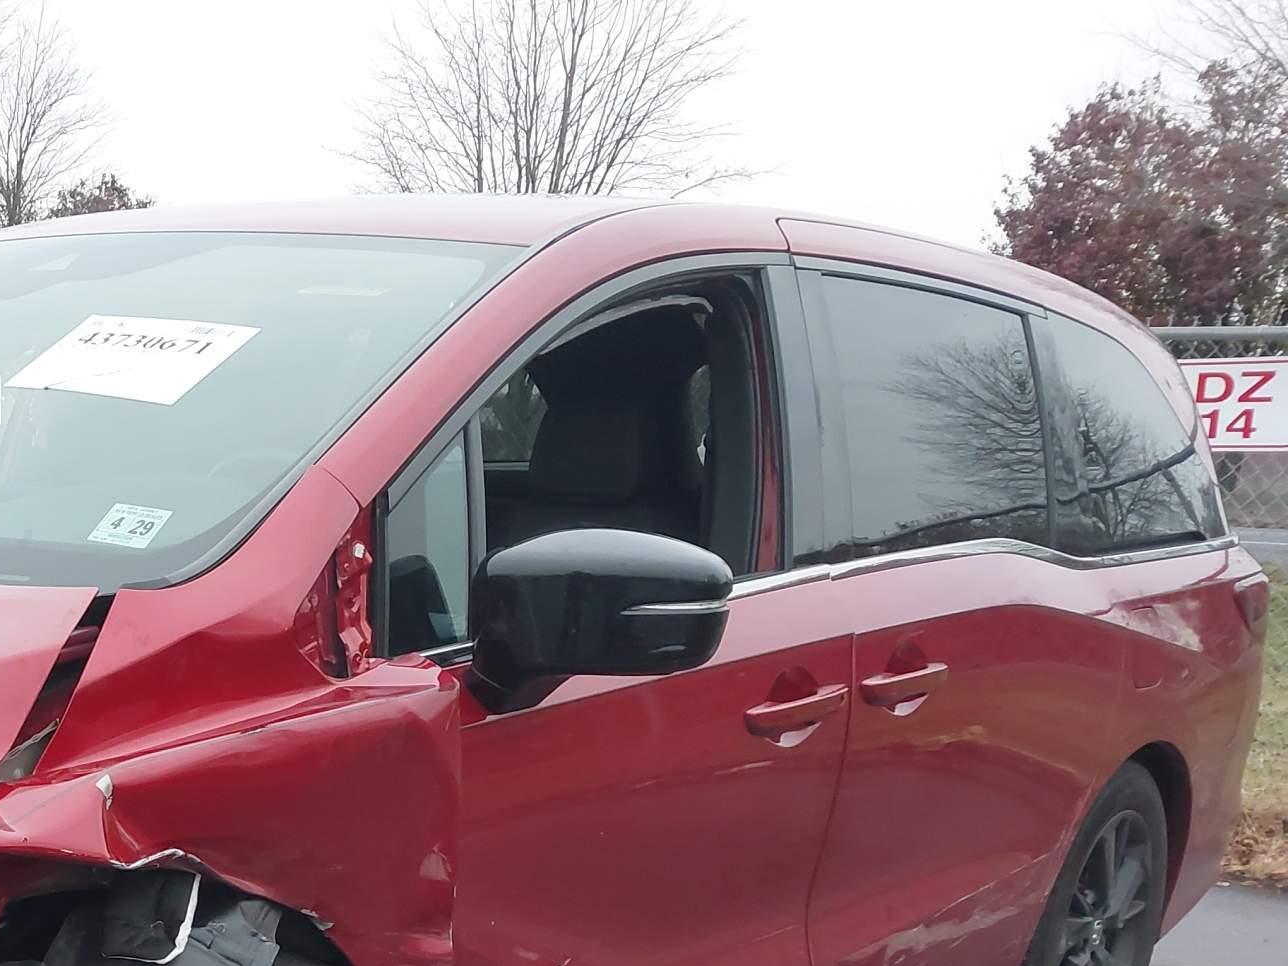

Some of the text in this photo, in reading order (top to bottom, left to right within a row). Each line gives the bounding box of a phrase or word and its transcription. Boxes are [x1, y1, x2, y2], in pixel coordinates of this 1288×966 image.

[78, 332, 212, 354] 43730671
[1195, 370, 1276, 403] DZ
[1201, 408, 1257, 439] 14
[110, 516, 155, 536] 4 29
